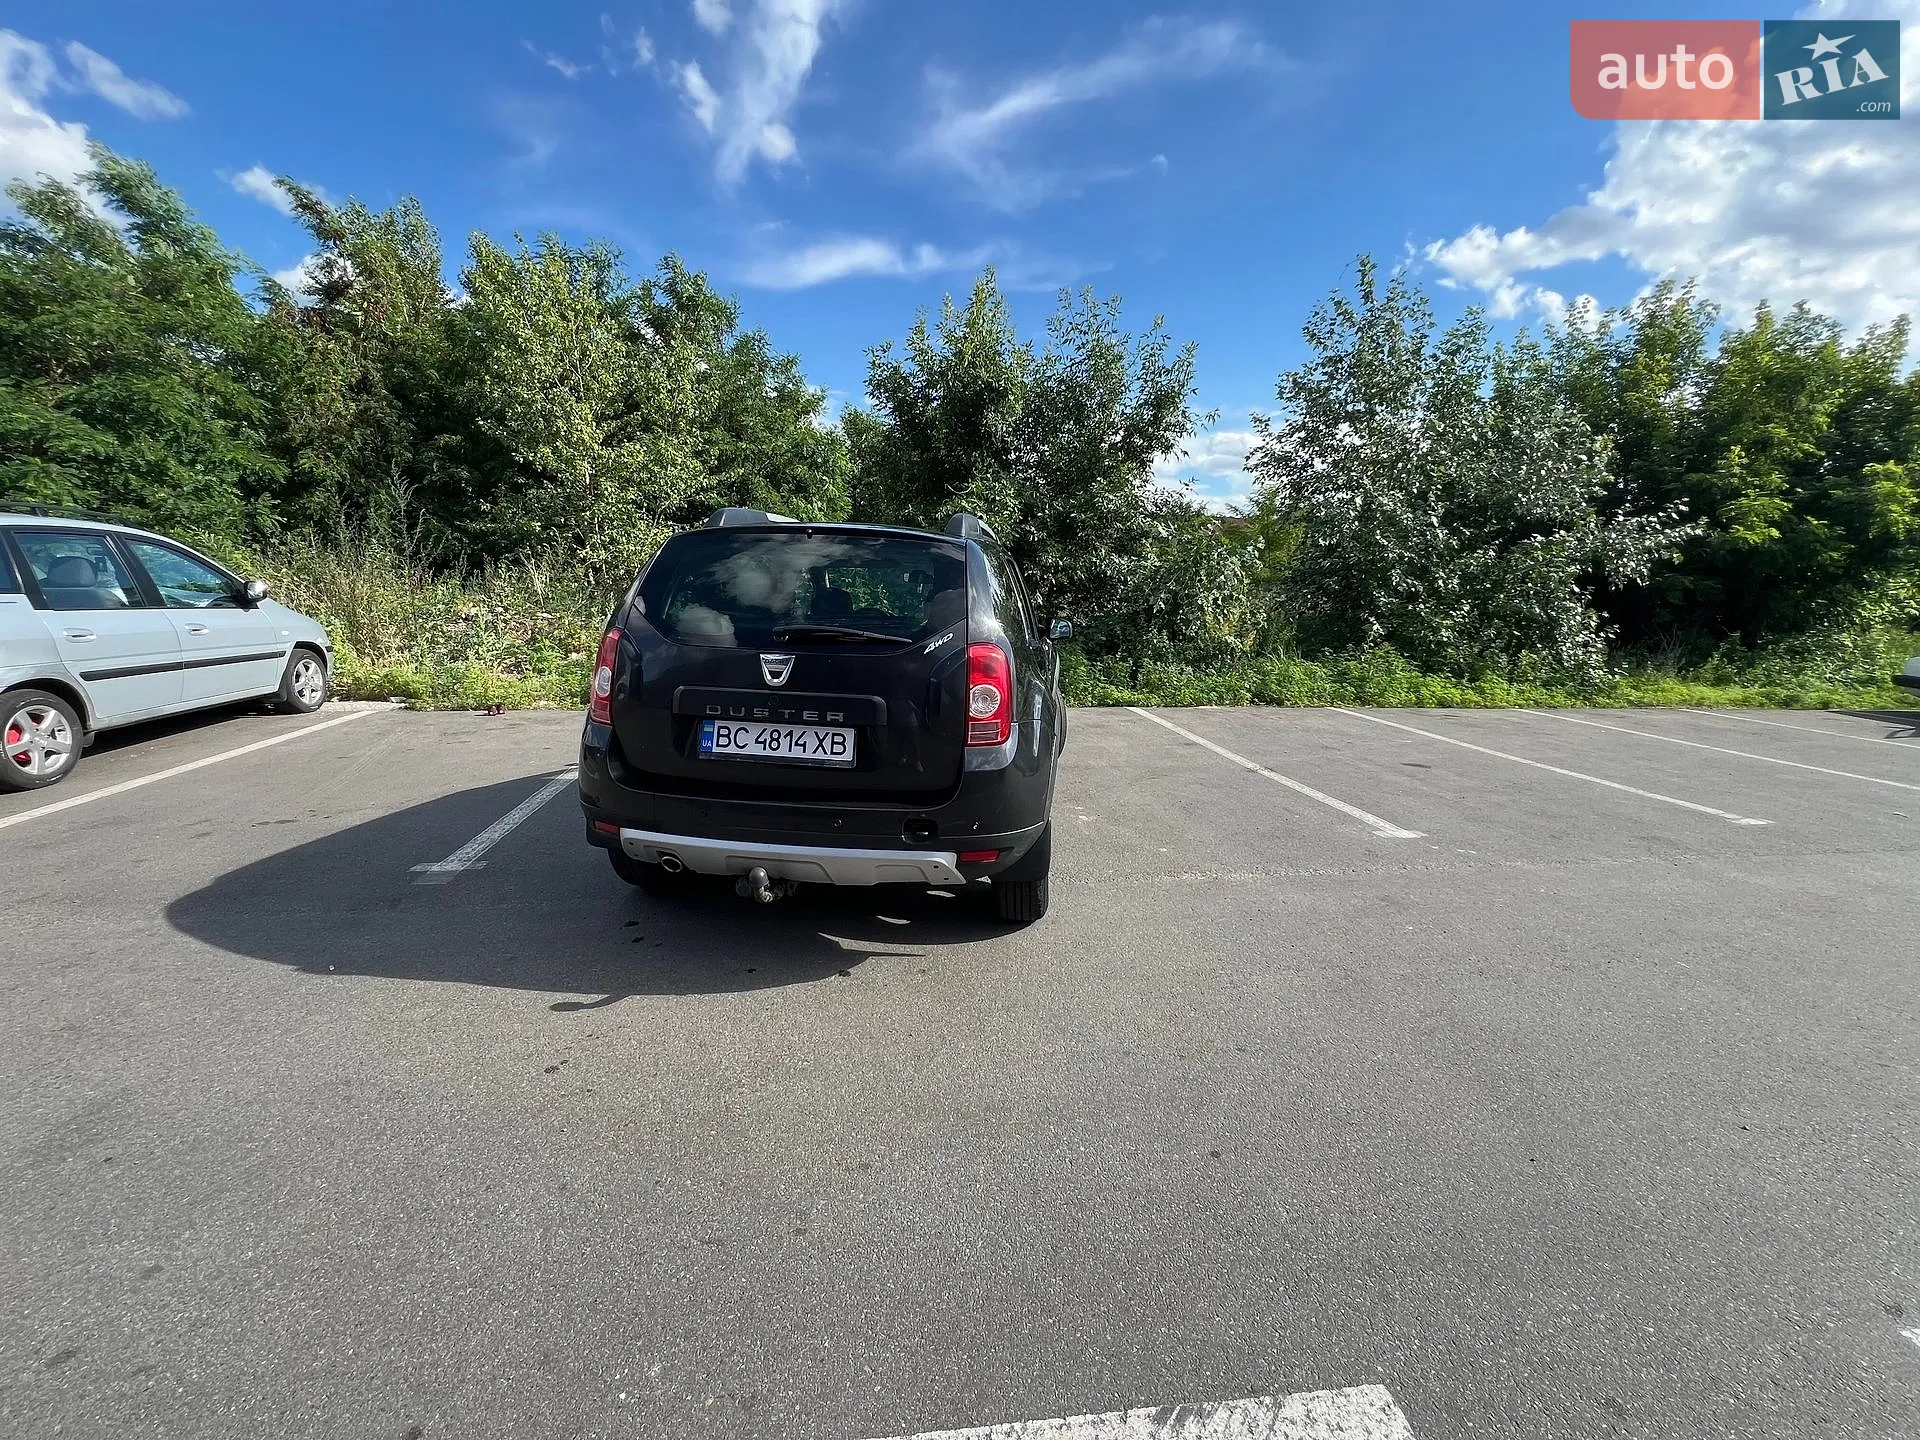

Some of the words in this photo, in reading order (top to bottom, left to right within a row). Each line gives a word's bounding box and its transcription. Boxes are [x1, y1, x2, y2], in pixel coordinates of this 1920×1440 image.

[924, 633, 954, 654] 4WD
[706, 705, 844, 722] DUSTER
[702, 739, 712, 747] UA
[715, 725, 750, 750] BC
[754, 727, 807, 754] 4814
[811, 730, 847, 756] XB
